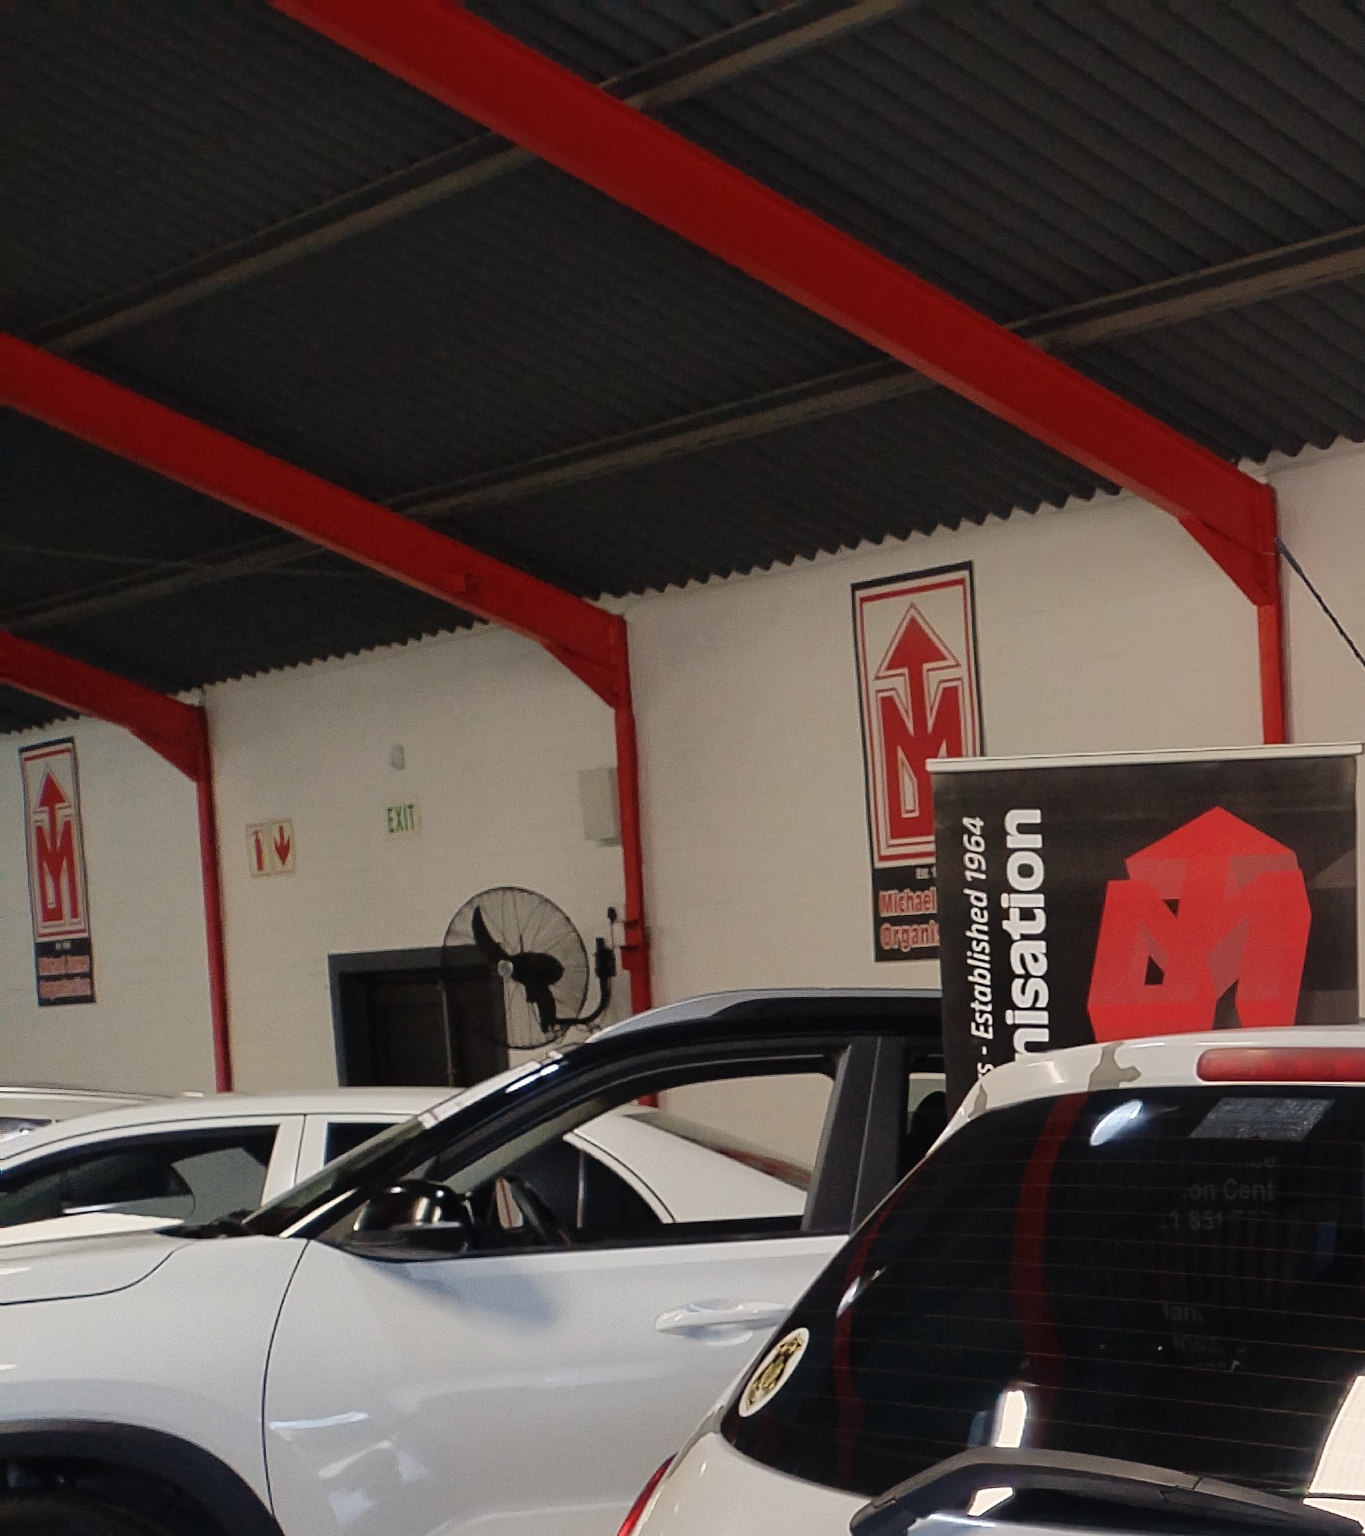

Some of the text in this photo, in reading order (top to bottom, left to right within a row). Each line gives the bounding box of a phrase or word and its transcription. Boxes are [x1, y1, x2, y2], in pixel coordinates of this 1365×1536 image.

[387, 804, 415, 833] EXIT
[962, 815, 988, 882] 1964
[878, 886, 938, 917] Michael
[880, 920, 941, 952] Organi
[963, 888, 994, 1040] Established
